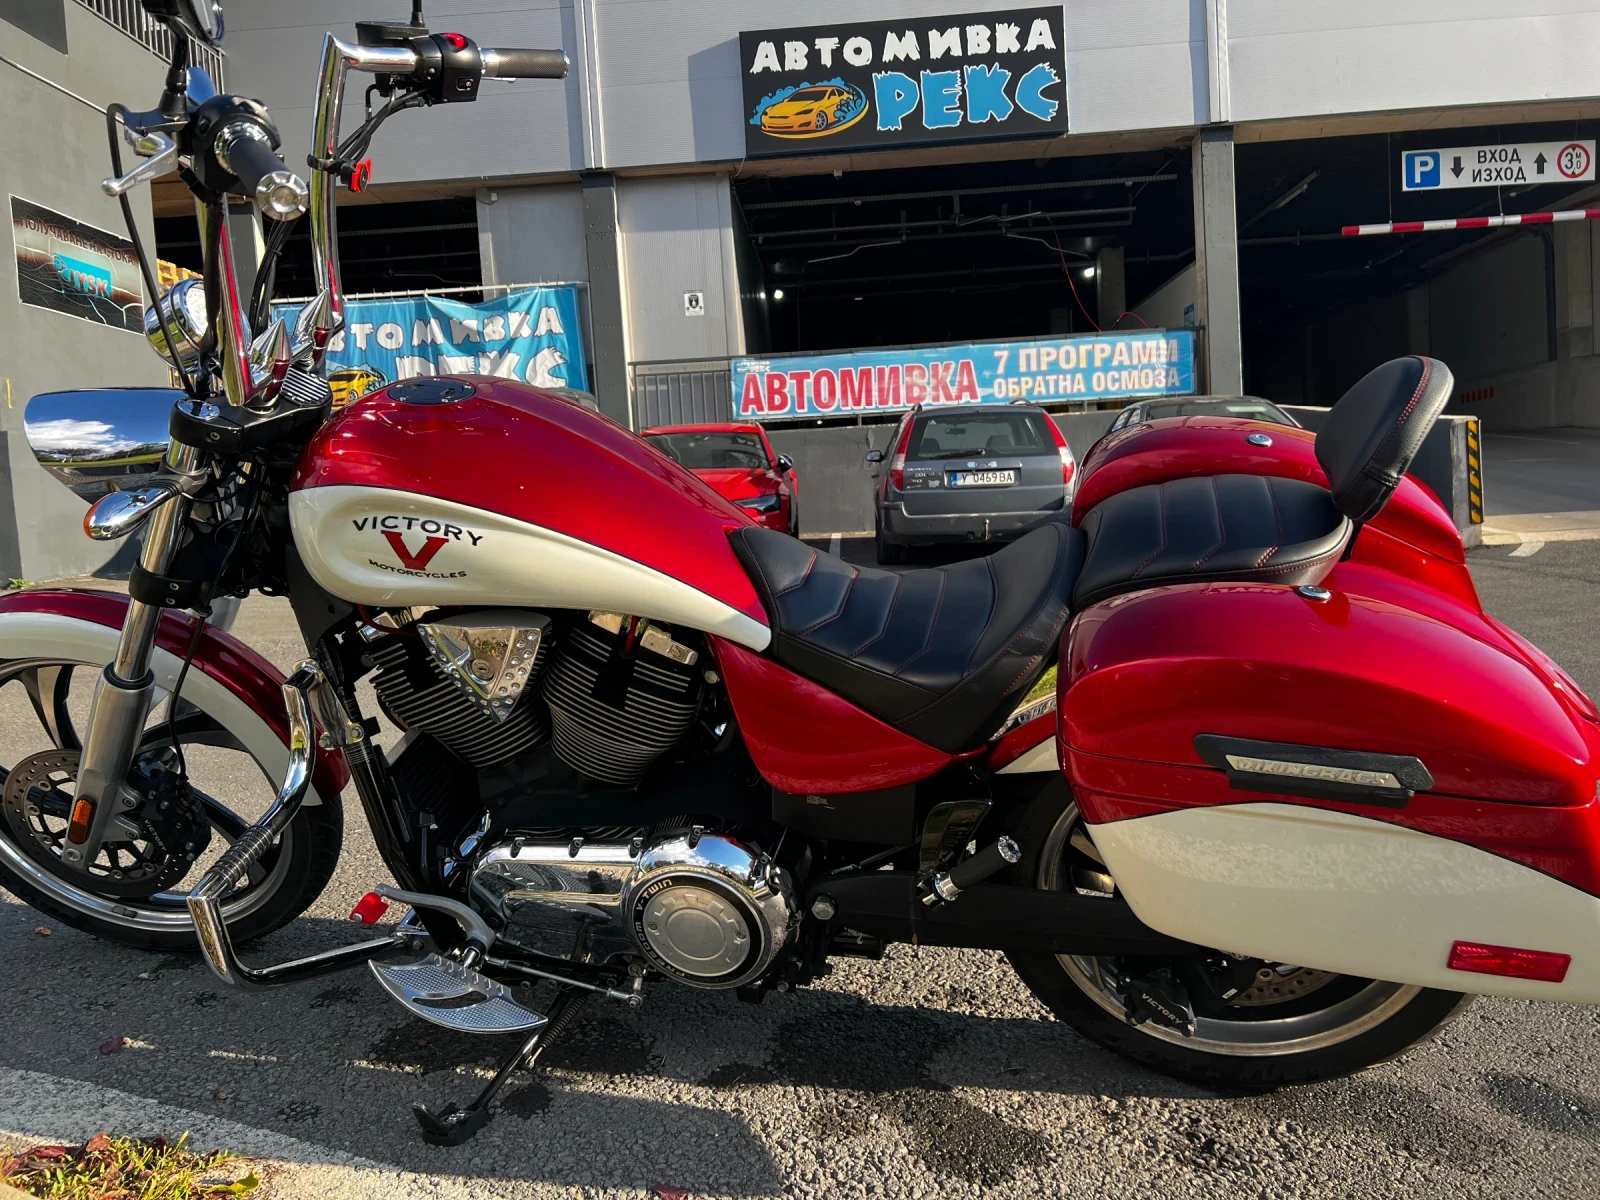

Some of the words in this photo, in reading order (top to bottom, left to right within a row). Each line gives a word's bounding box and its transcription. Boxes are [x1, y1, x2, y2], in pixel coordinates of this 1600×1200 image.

[750, 18, 1056, 74] АВТОМИВКА
[872, 62, 1061, 131] РЕКС
[1477, 148, 1521, 164] ВХОД
[1472, 166, 1526, 183] ИЗХОД
[20, 217, 88, 250] ПОЛУЧАВАНЕ
[69, 269, 110, 298] JYSK
[327, 306, 564, 351] ВТОМИВКА
[993, 350, 1009, 374] 7
[1019, 339, 1179, 372] ПРОГРАМИ
[740, 359, 980, 415] АВТОМИВКА
[993, 373, 1085, 399] ОБРАТНА
[1092, 367, 1180, 393] ОСМОЗА
[352, 515, 484, 546] VICTORY
[368, 559, 467, 579] MOTORCYCLES
[1234, 757, 1390, 786] VIKINGBAGS
[144, 819, 168, 851] VICTORY
[636, 879, 673, 911] V-TWIN
[1141, 993, 1184, 1024] VICTORY
